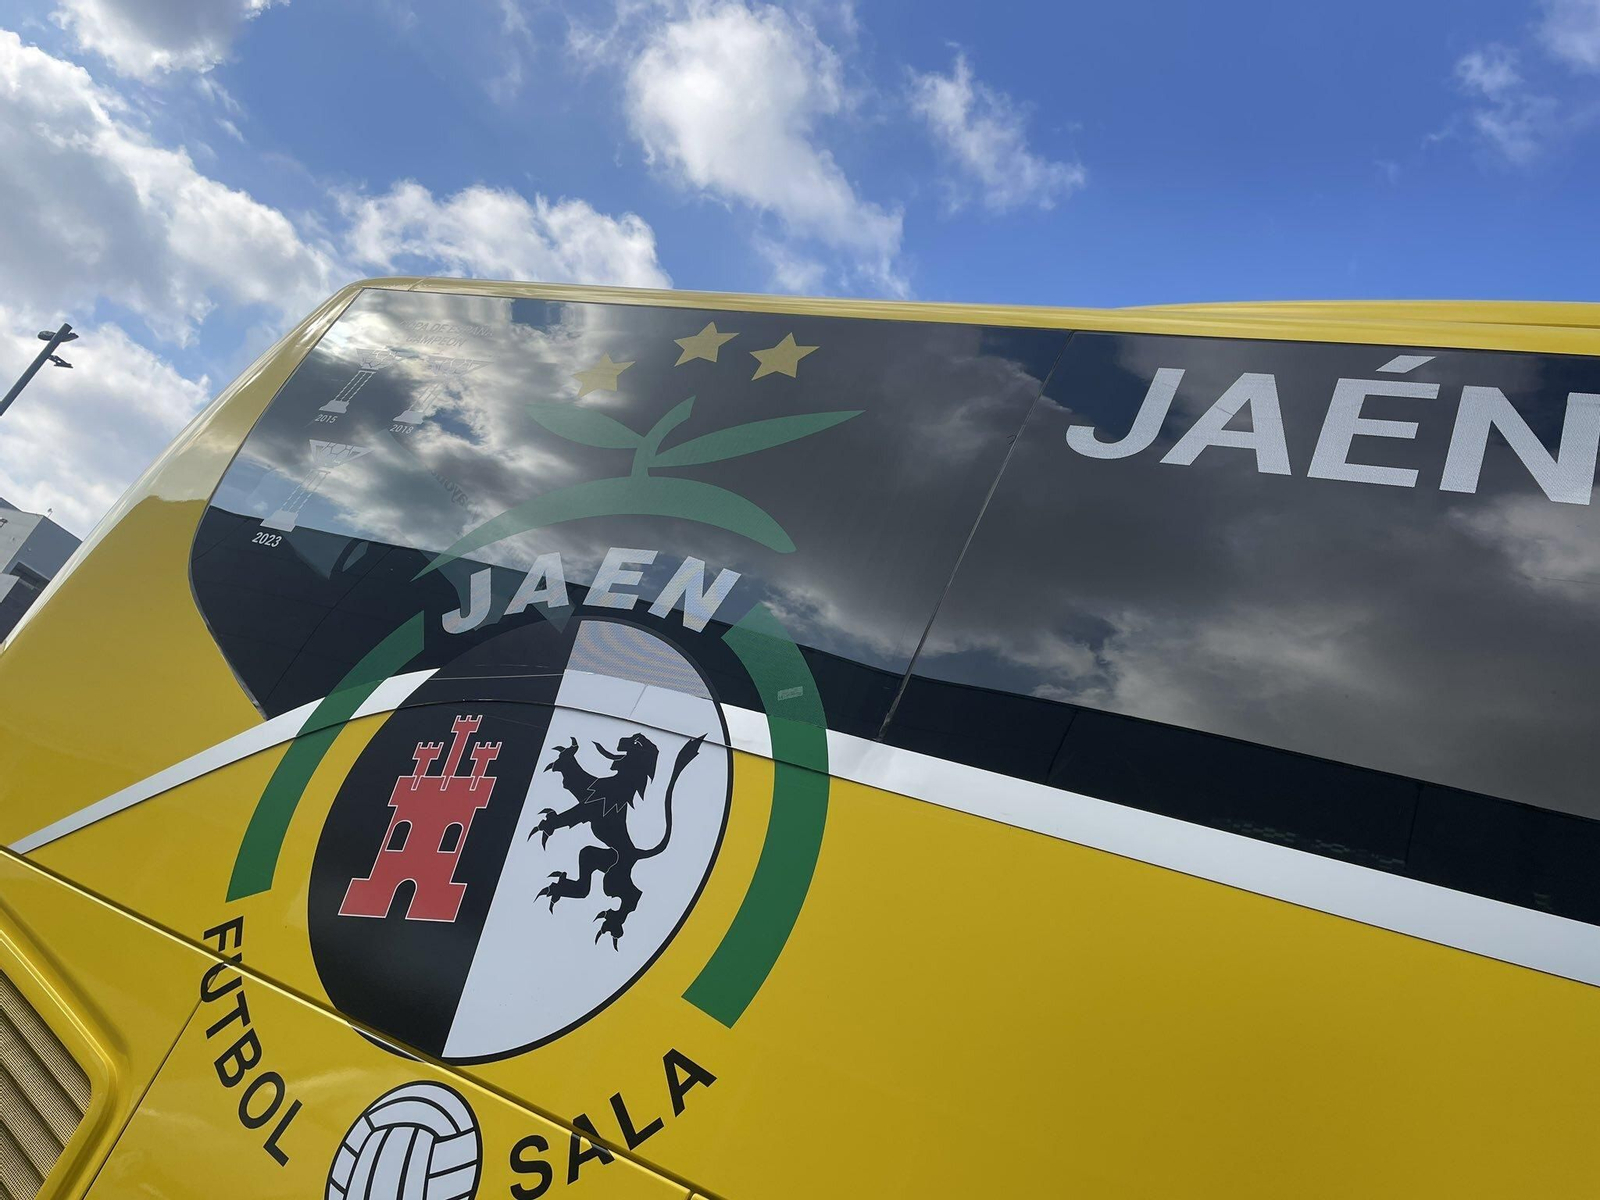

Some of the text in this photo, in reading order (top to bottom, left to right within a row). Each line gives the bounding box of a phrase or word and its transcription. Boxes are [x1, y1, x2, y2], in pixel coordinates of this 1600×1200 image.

[430, 323, 449, 333] DE
[315, 414, 338, 424] 2015
[390, 424, 414, 434] 2018
[1066, 355, 1600, 505] JAÉN
[252, 532, 282, 547] 2023
[442, 547, 741, 634] JAEN
[201, 916, 717, 1200] FUTBOL SALA
